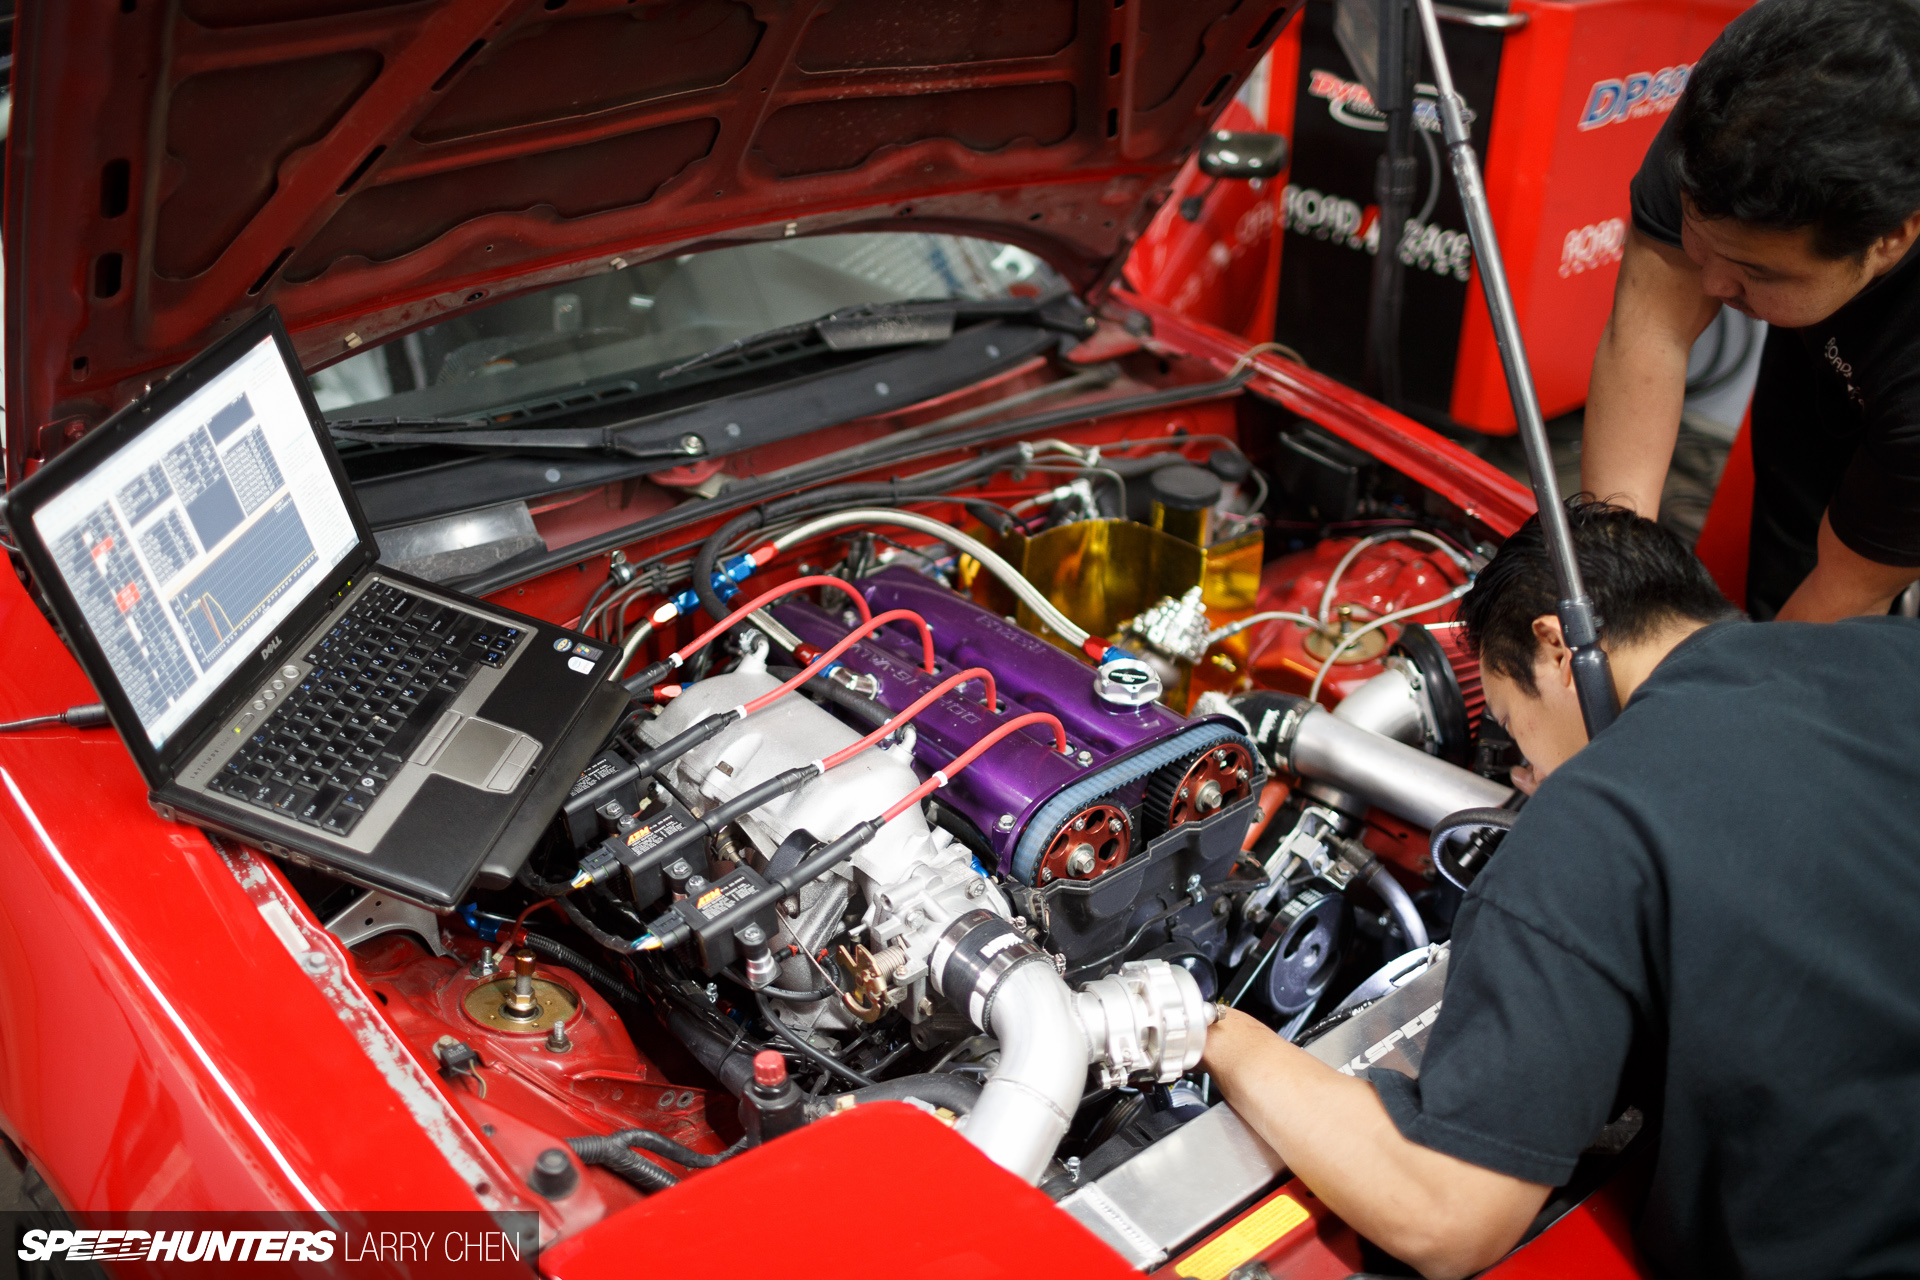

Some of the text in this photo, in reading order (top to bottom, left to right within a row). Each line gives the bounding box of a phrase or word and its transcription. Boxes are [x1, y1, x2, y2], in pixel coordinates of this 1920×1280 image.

[1828, 337, 1852, 373] ROAD
[261, 635, 283, 661] DELL
[627, 825, 651, 846] AEM
[696, 886, 722, 909] AEM
[1337, 1000, 1443, 1077] KSPEE
